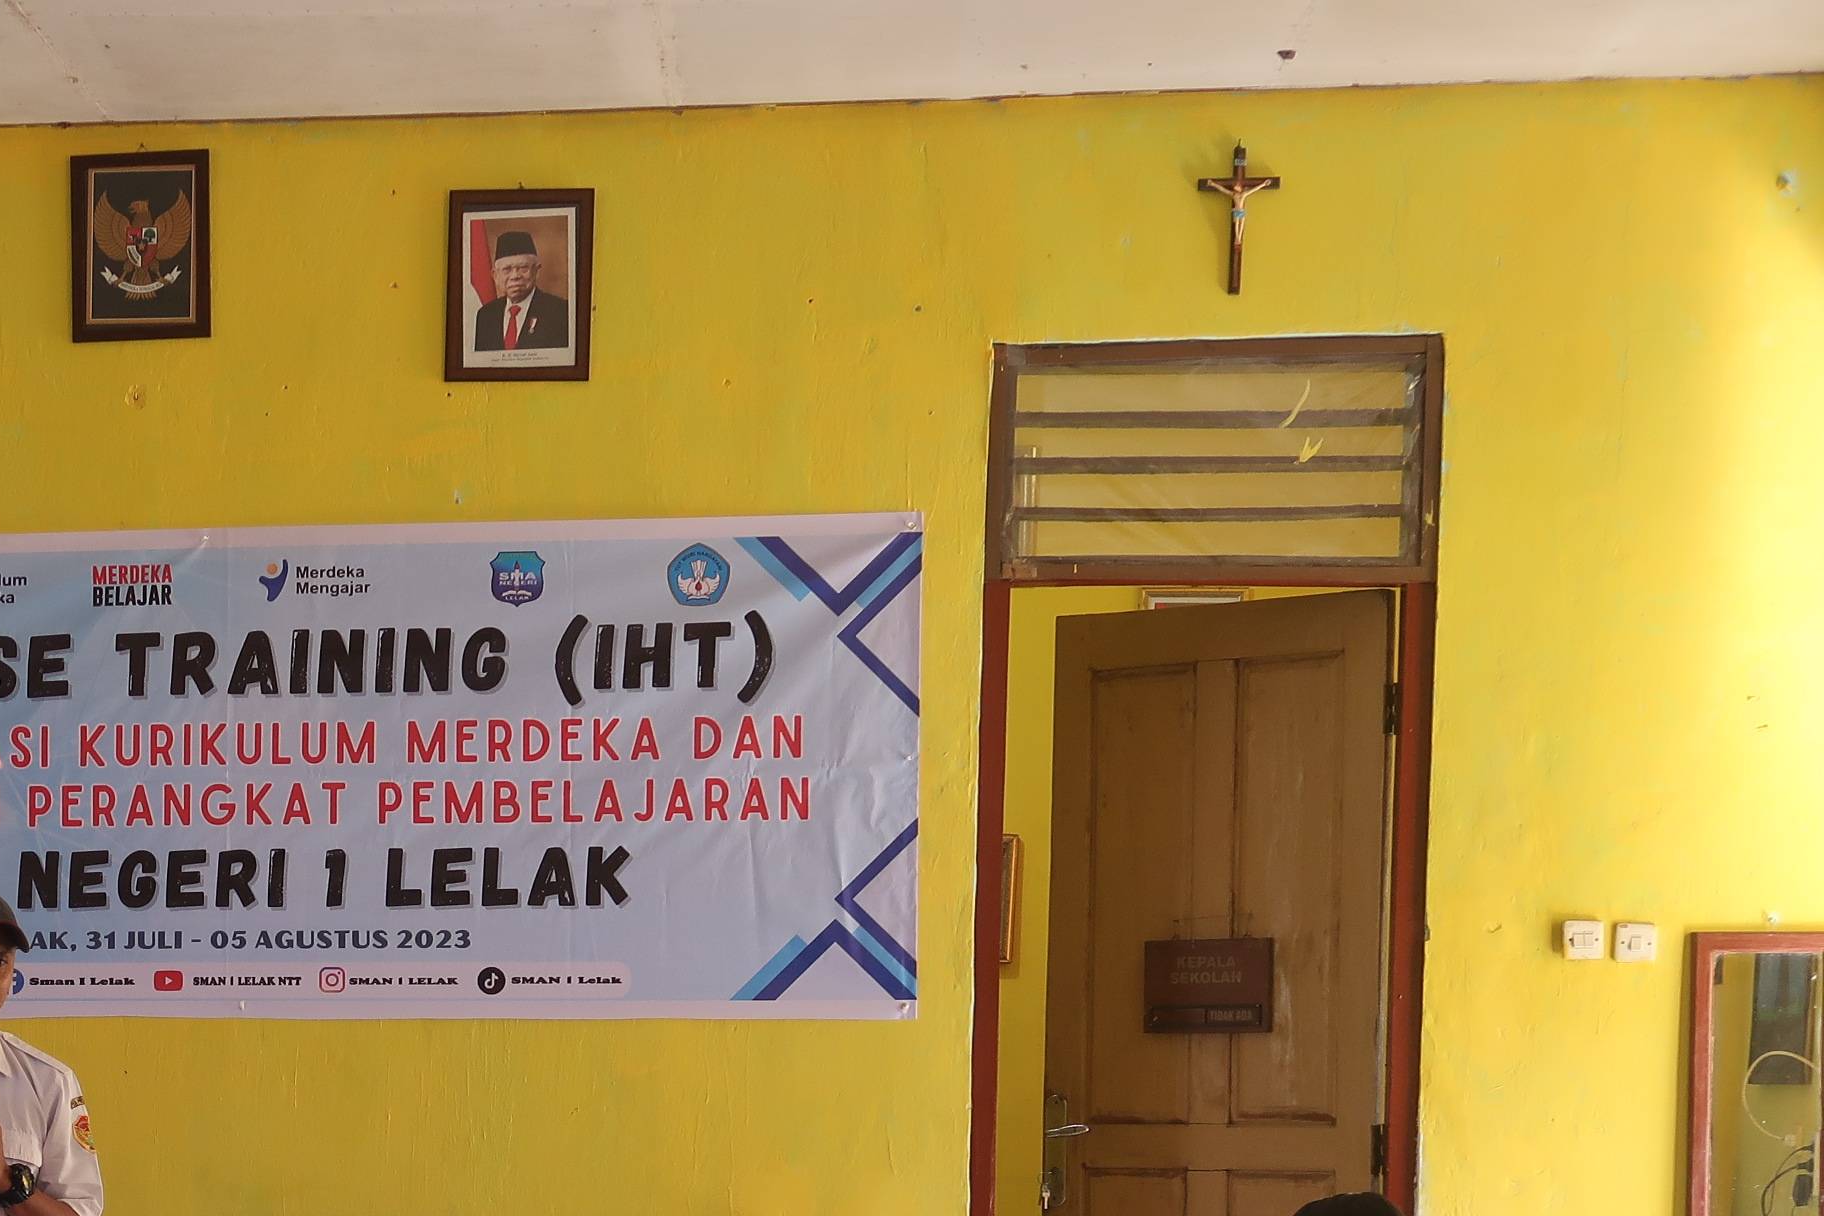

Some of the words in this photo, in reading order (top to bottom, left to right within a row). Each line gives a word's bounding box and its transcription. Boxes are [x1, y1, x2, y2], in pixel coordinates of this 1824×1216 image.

[92, 564, 173, 585] MERDEKA
[296, 566, 365, 579] Merdeka
[92, 585, 172, 607] BELAJAR
[296, 581, 371, 597] Mengajar
[114, 626, 508, 698] TRAINING
[555, 610, 774, 706] (IHT)
[79, 720, 376, 767] KURIKULUM
[407, 715, 661, 764] MERDEKA
[693, 714, 804, 760] DAN
[27, 781, 346, 828] PERANGKAT
[378, 775, 812, 824] PEMBELAJARAN
[17, 848, 285, 909] NEGERI
[325, 849, 347, 908] 1
[385, 846, 631, 908] LELAK
[28, 931, 76, 952] AK,
[86, 931, 116, 950] 31
[124, 931, 183, 951] JULI
[210, 930, 247, 949] 05
[255, 930, 388, 950] AGUSTUS
[397, 929, 472, 949] 2023
[1176, 956, 1237, 969] KEPALA
[29, 977, 75, 986] Sman
[90, 977, 136, 986] Lelak
[192, 976, 226, 986] SMAN
[238, 976, 276, 986] LELAK
[278, 976, 302, 986] NTT
[349, 977, 393, 985] SMAN
[408, 977, 458, 985] LELAK
[511, 976, 561, 985] SMAN
[577, 976, 623, 985] Lelak
[1170, 971, 1243, 984] SEKOLAH
